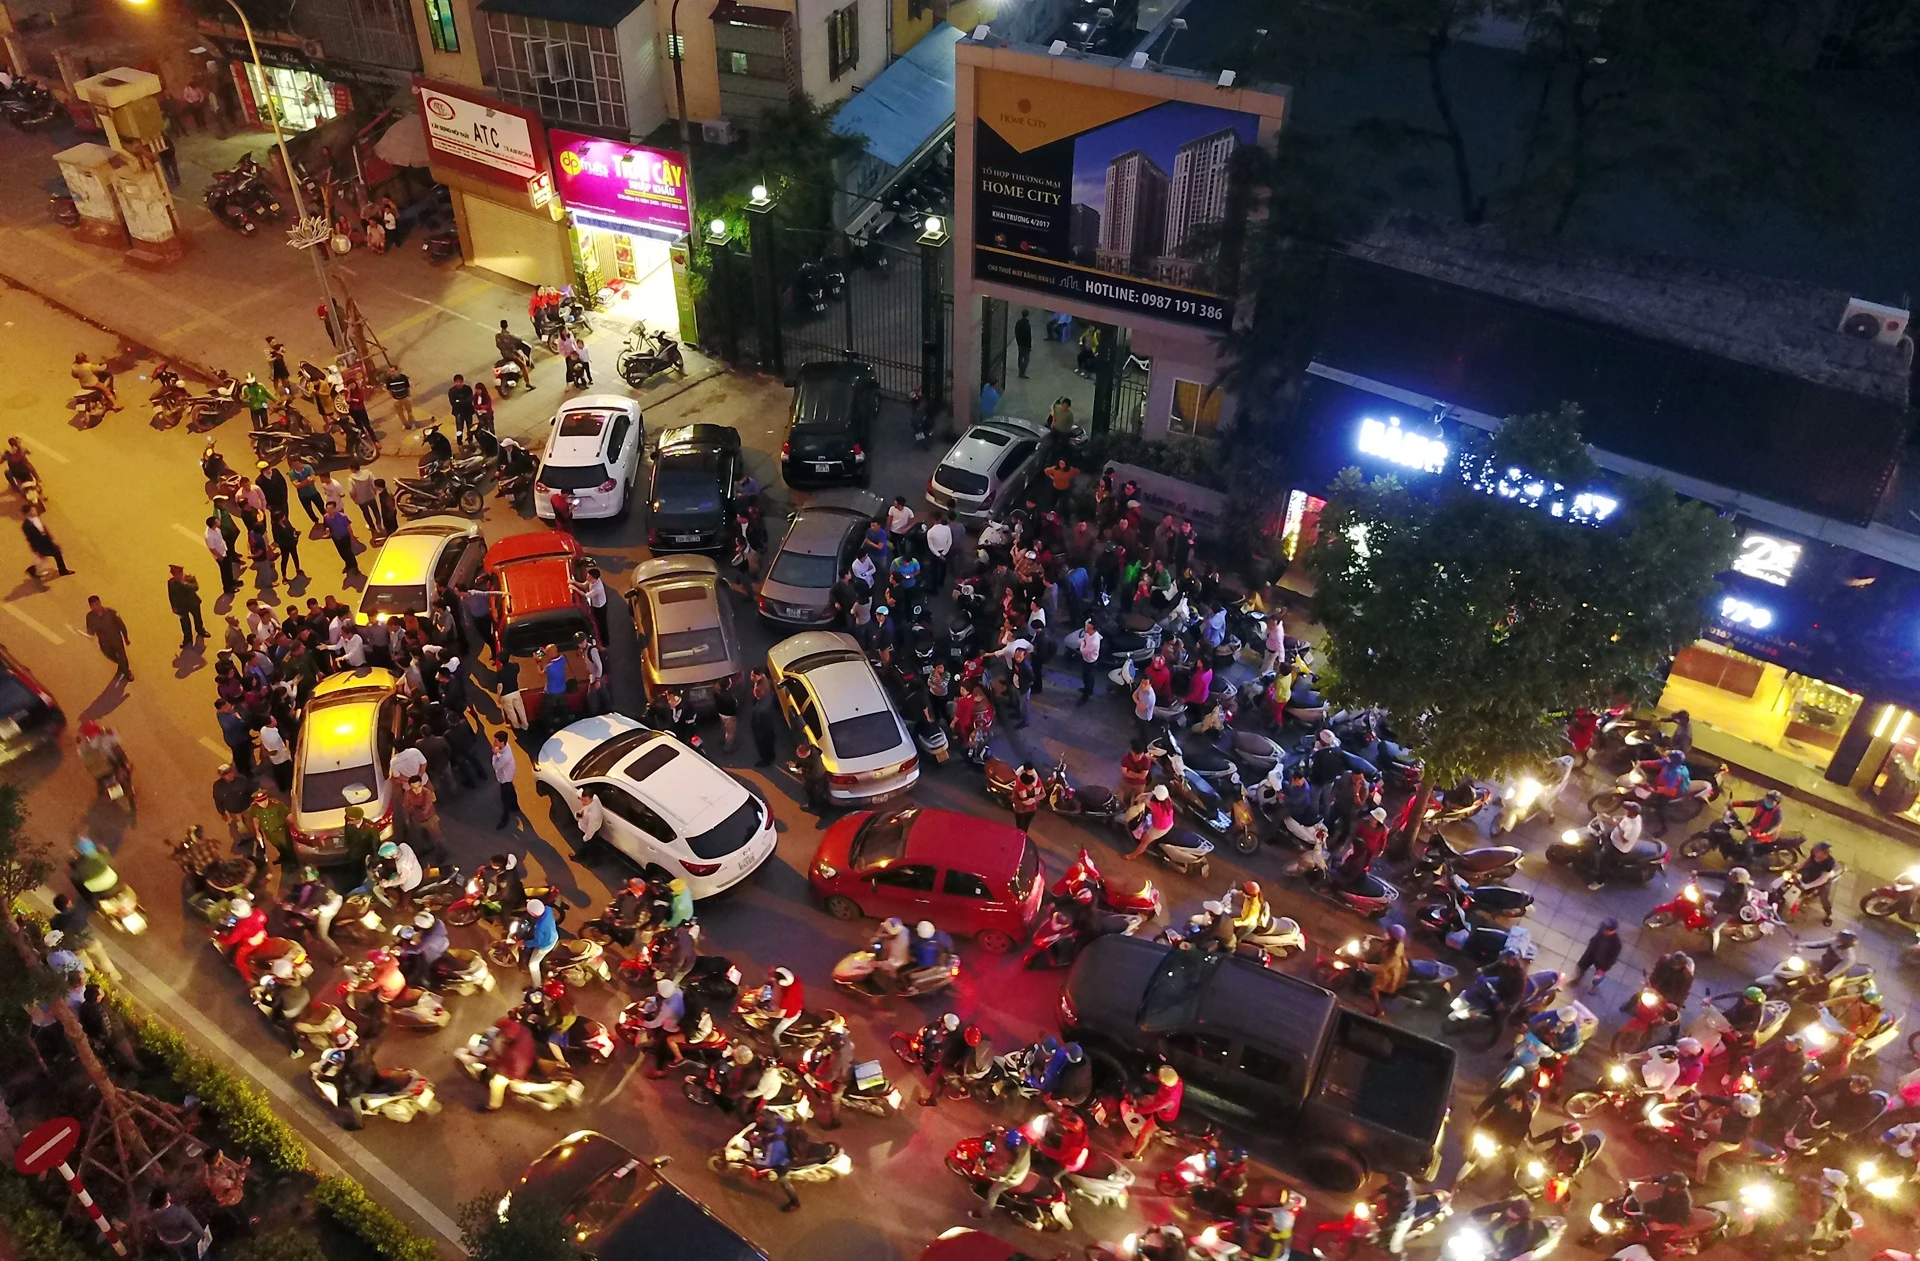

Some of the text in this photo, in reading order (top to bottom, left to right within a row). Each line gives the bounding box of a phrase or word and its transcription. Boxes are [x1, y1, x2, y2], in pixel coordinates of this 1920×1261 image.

[1000, 113, 1048, 129] HOME CITY
[473, 122, 500, 149] ATC
[652, 159, 682, 188] CÂY
[993, 170, 1010, 179] HỢP
[1012, 173, 1045, 185] THƯƠNG
[1046, 179, 1061, 189] MẠI
[982, 180, 1061, 206] HOME CITY
[992, 210, 1006, 220] KHAI
[1030, 218, 1051, 229] 4/2017
[987, 264, 998, 272] CHO
[999, 266, 1012, 275] THUÊ
[1085, 280, 1223, 320] HOTLINE: 0987 191 386
